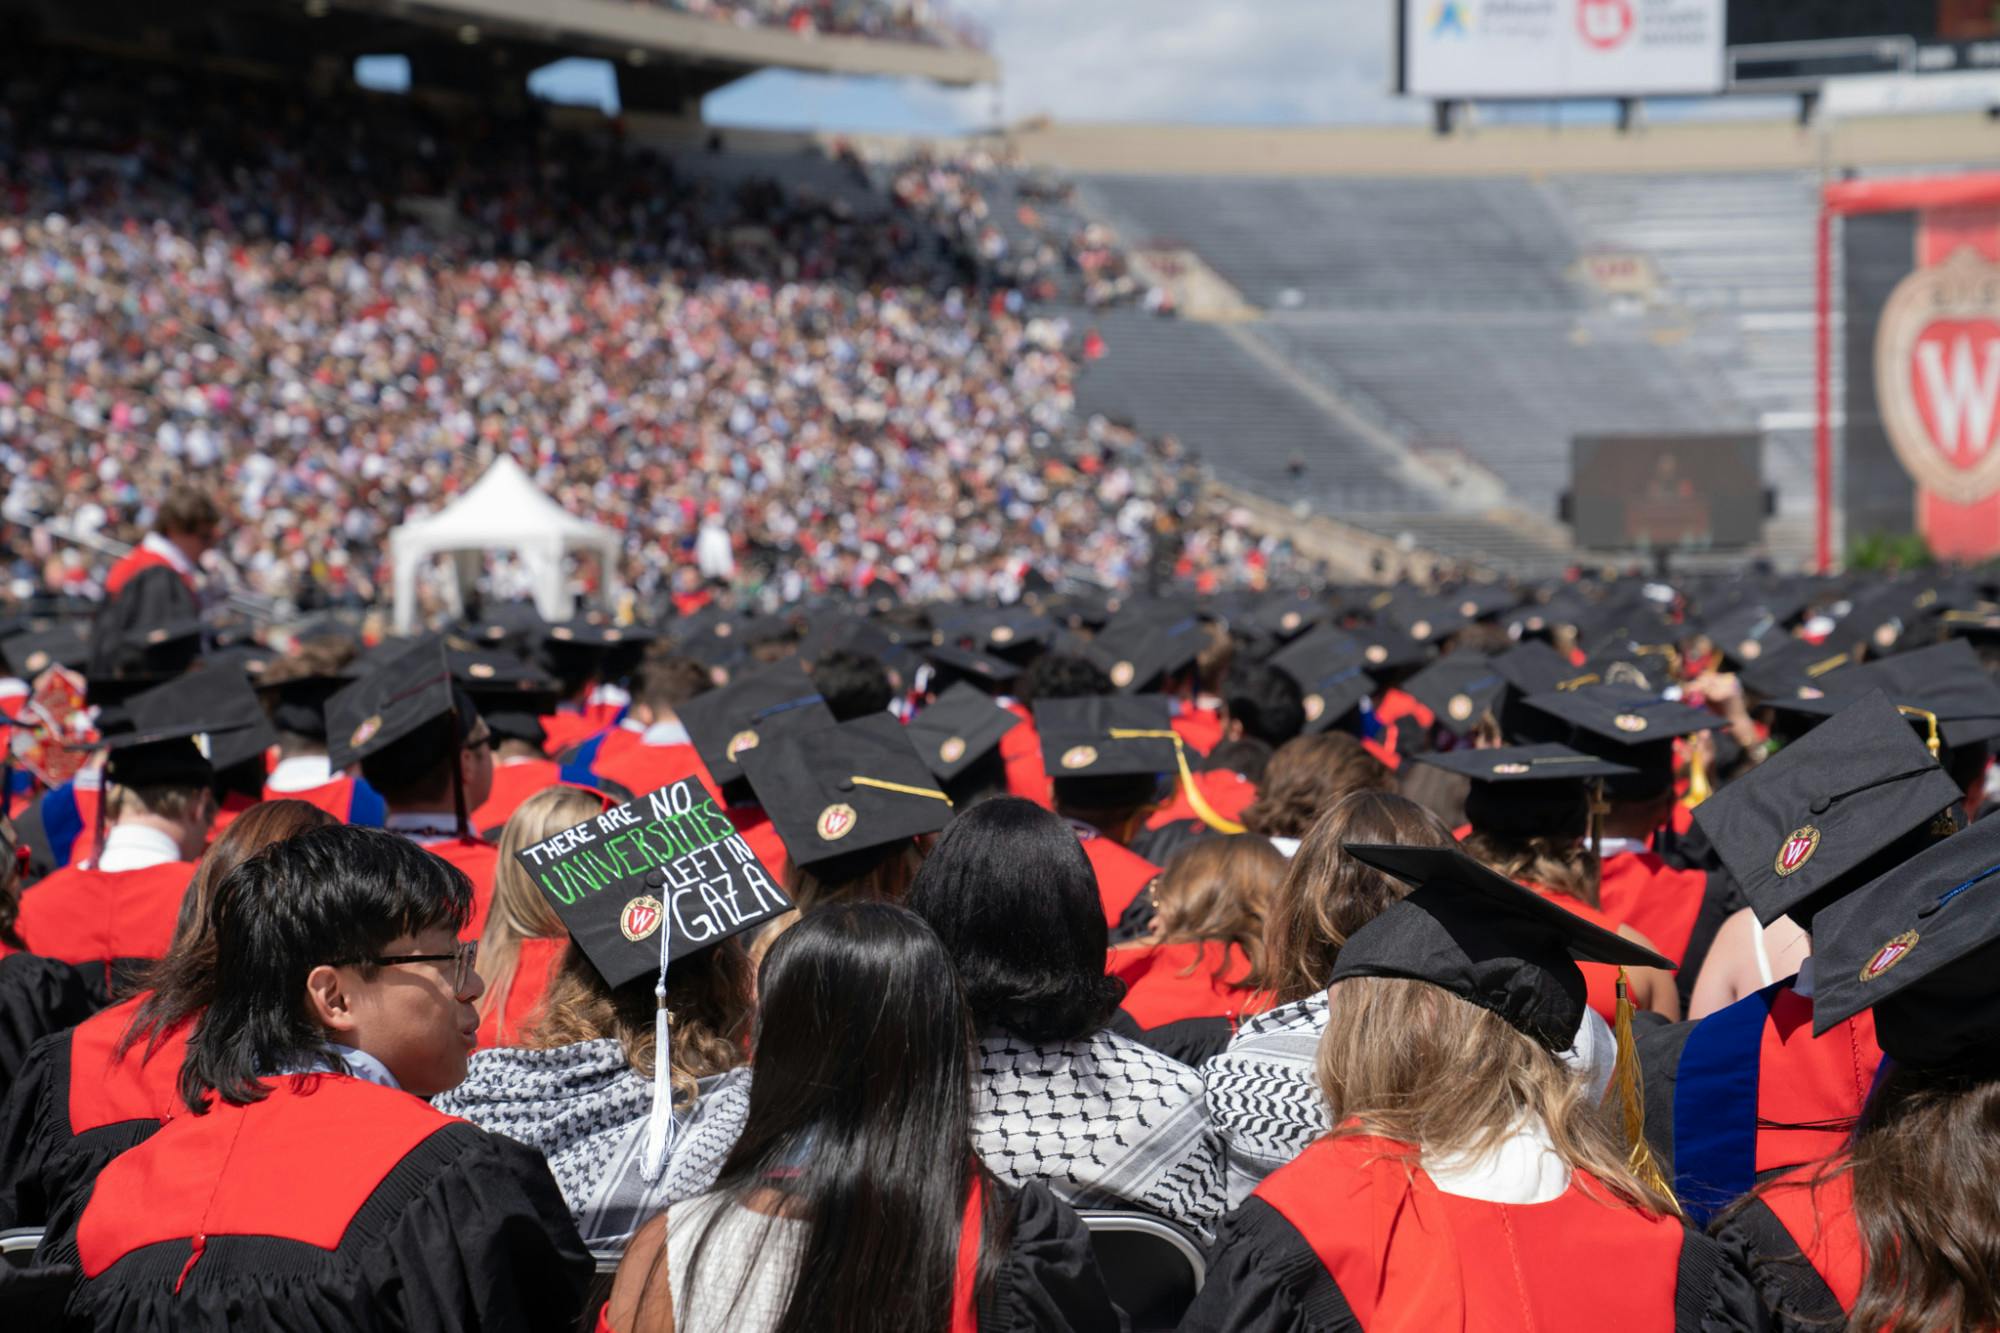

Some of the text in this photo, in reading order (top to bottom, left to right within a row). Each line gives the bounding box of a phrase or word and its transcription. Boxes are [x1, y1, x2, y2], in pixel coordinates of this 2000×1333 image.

[1916, 332, 2000, 454] W
[522, 781, 693, 866] THERE ARE NO
[540, 797, 736, 905] UNIVERSITIES
[660, 833, 756, 889] LEFT IN
[1786, 840, 1810, 865] W
[633, 909, 655, 931] W
[671, 861, 788, 942] GAZA
